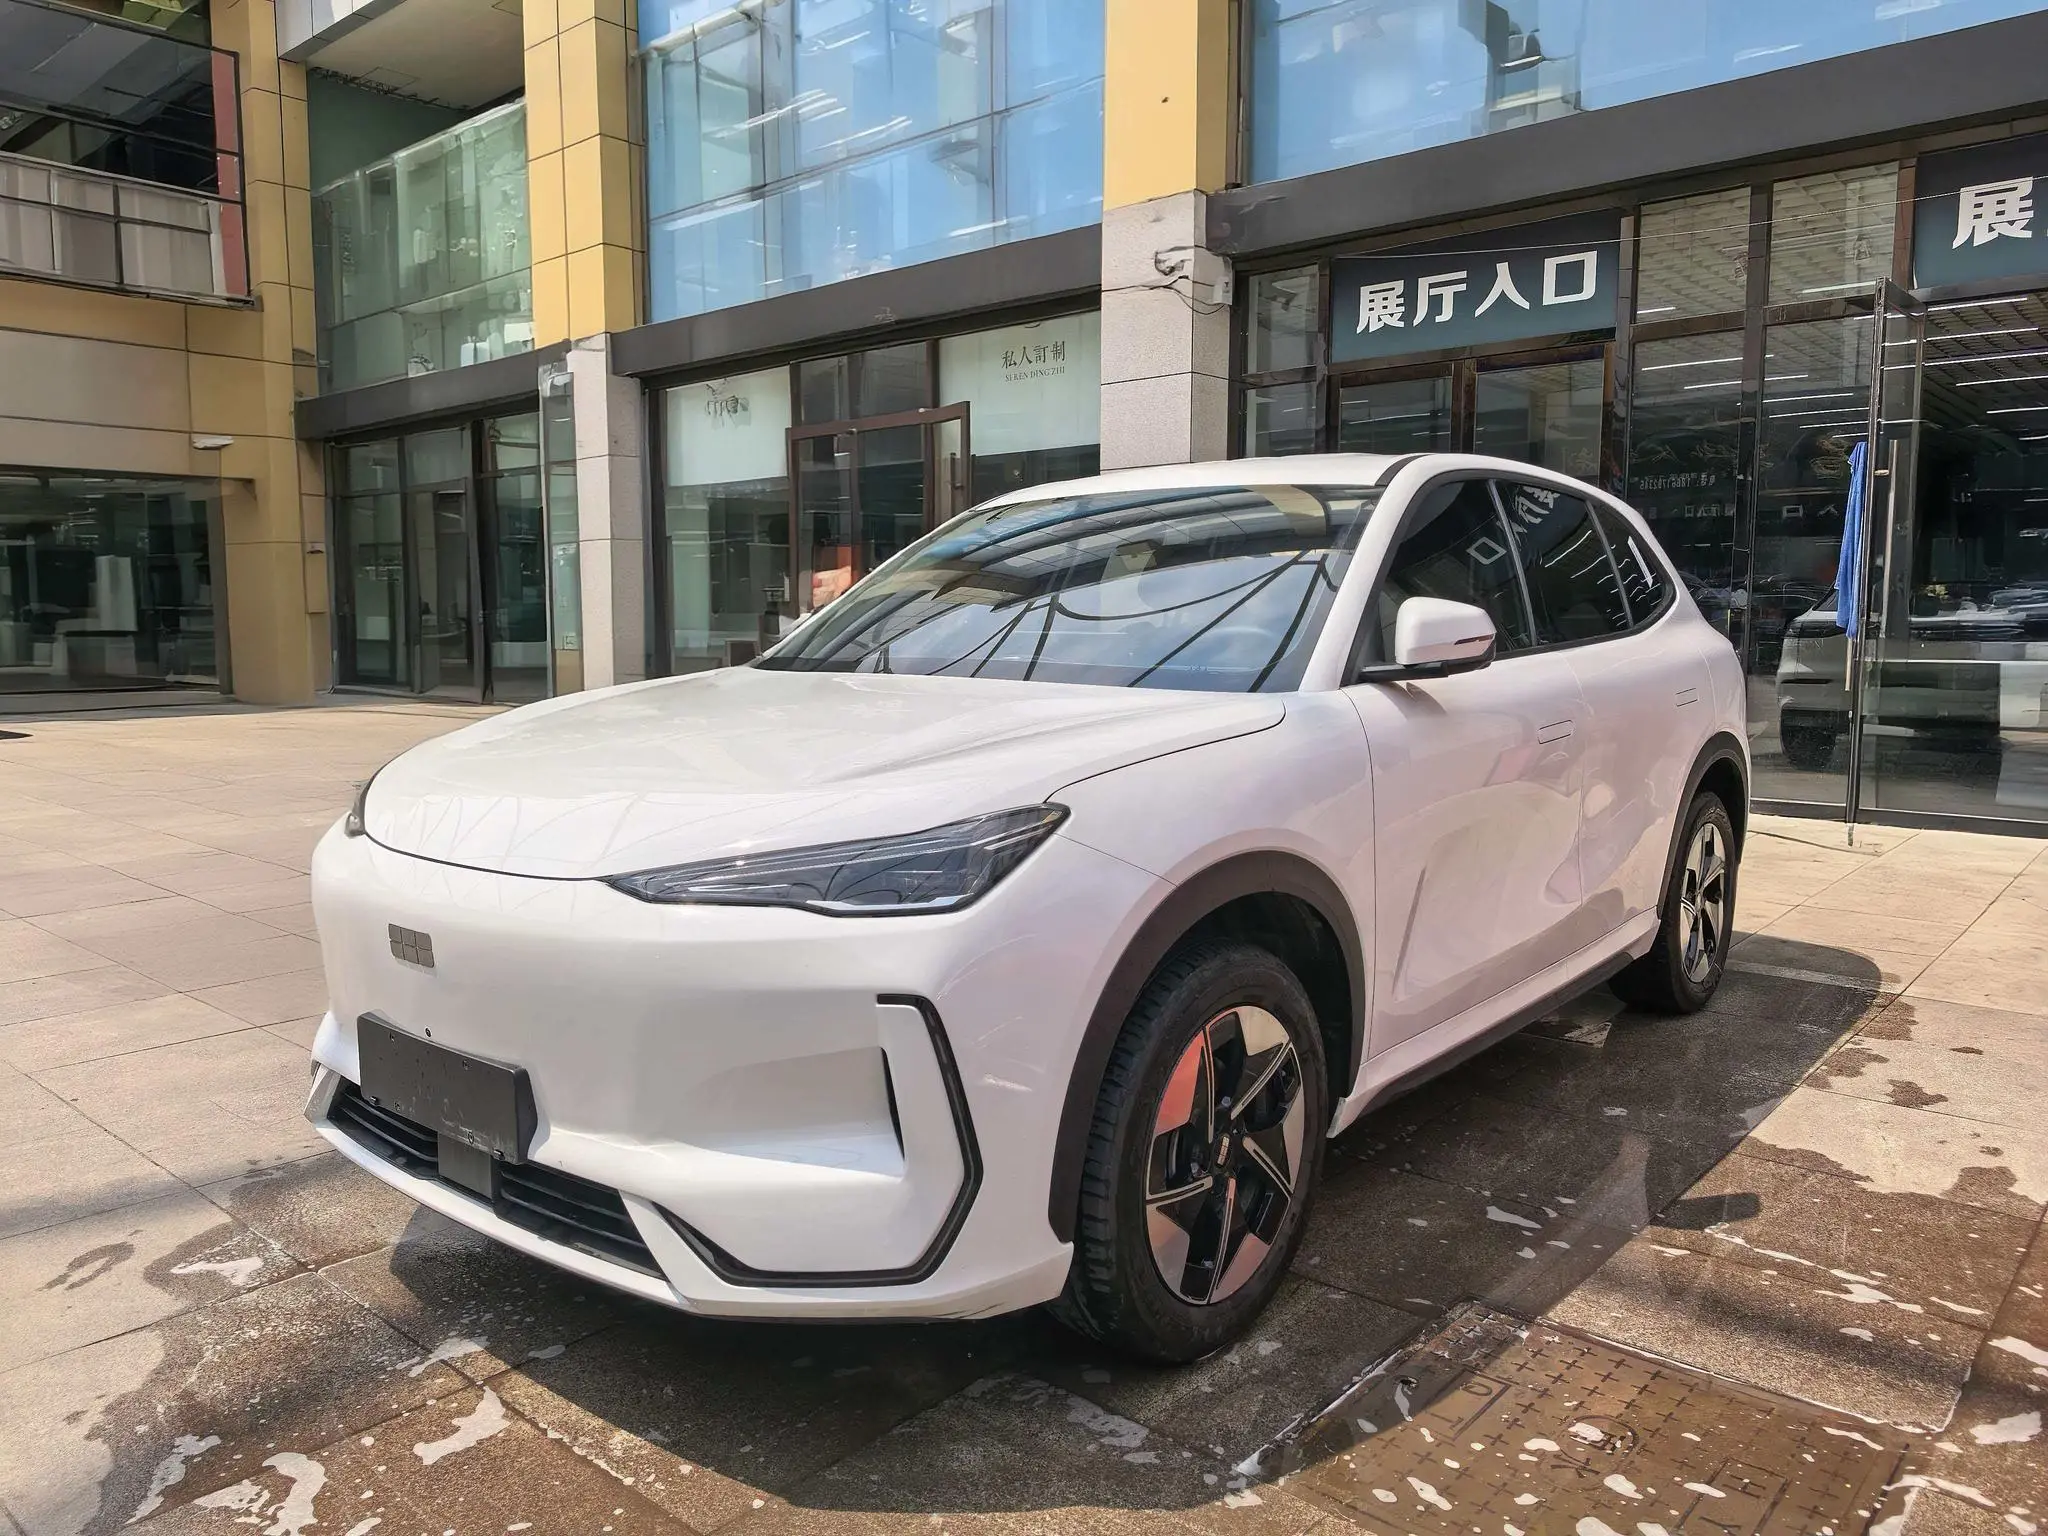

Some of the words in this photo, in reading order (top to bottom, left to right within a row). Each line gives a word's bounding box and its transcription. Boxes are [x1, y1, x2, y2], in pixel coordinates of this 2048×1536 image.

[1952, 176, 2034, 250] 展
[1356, 250, 1598, 335] 展厅入口
[1001, 340, 1066, 370] 私人訂制
